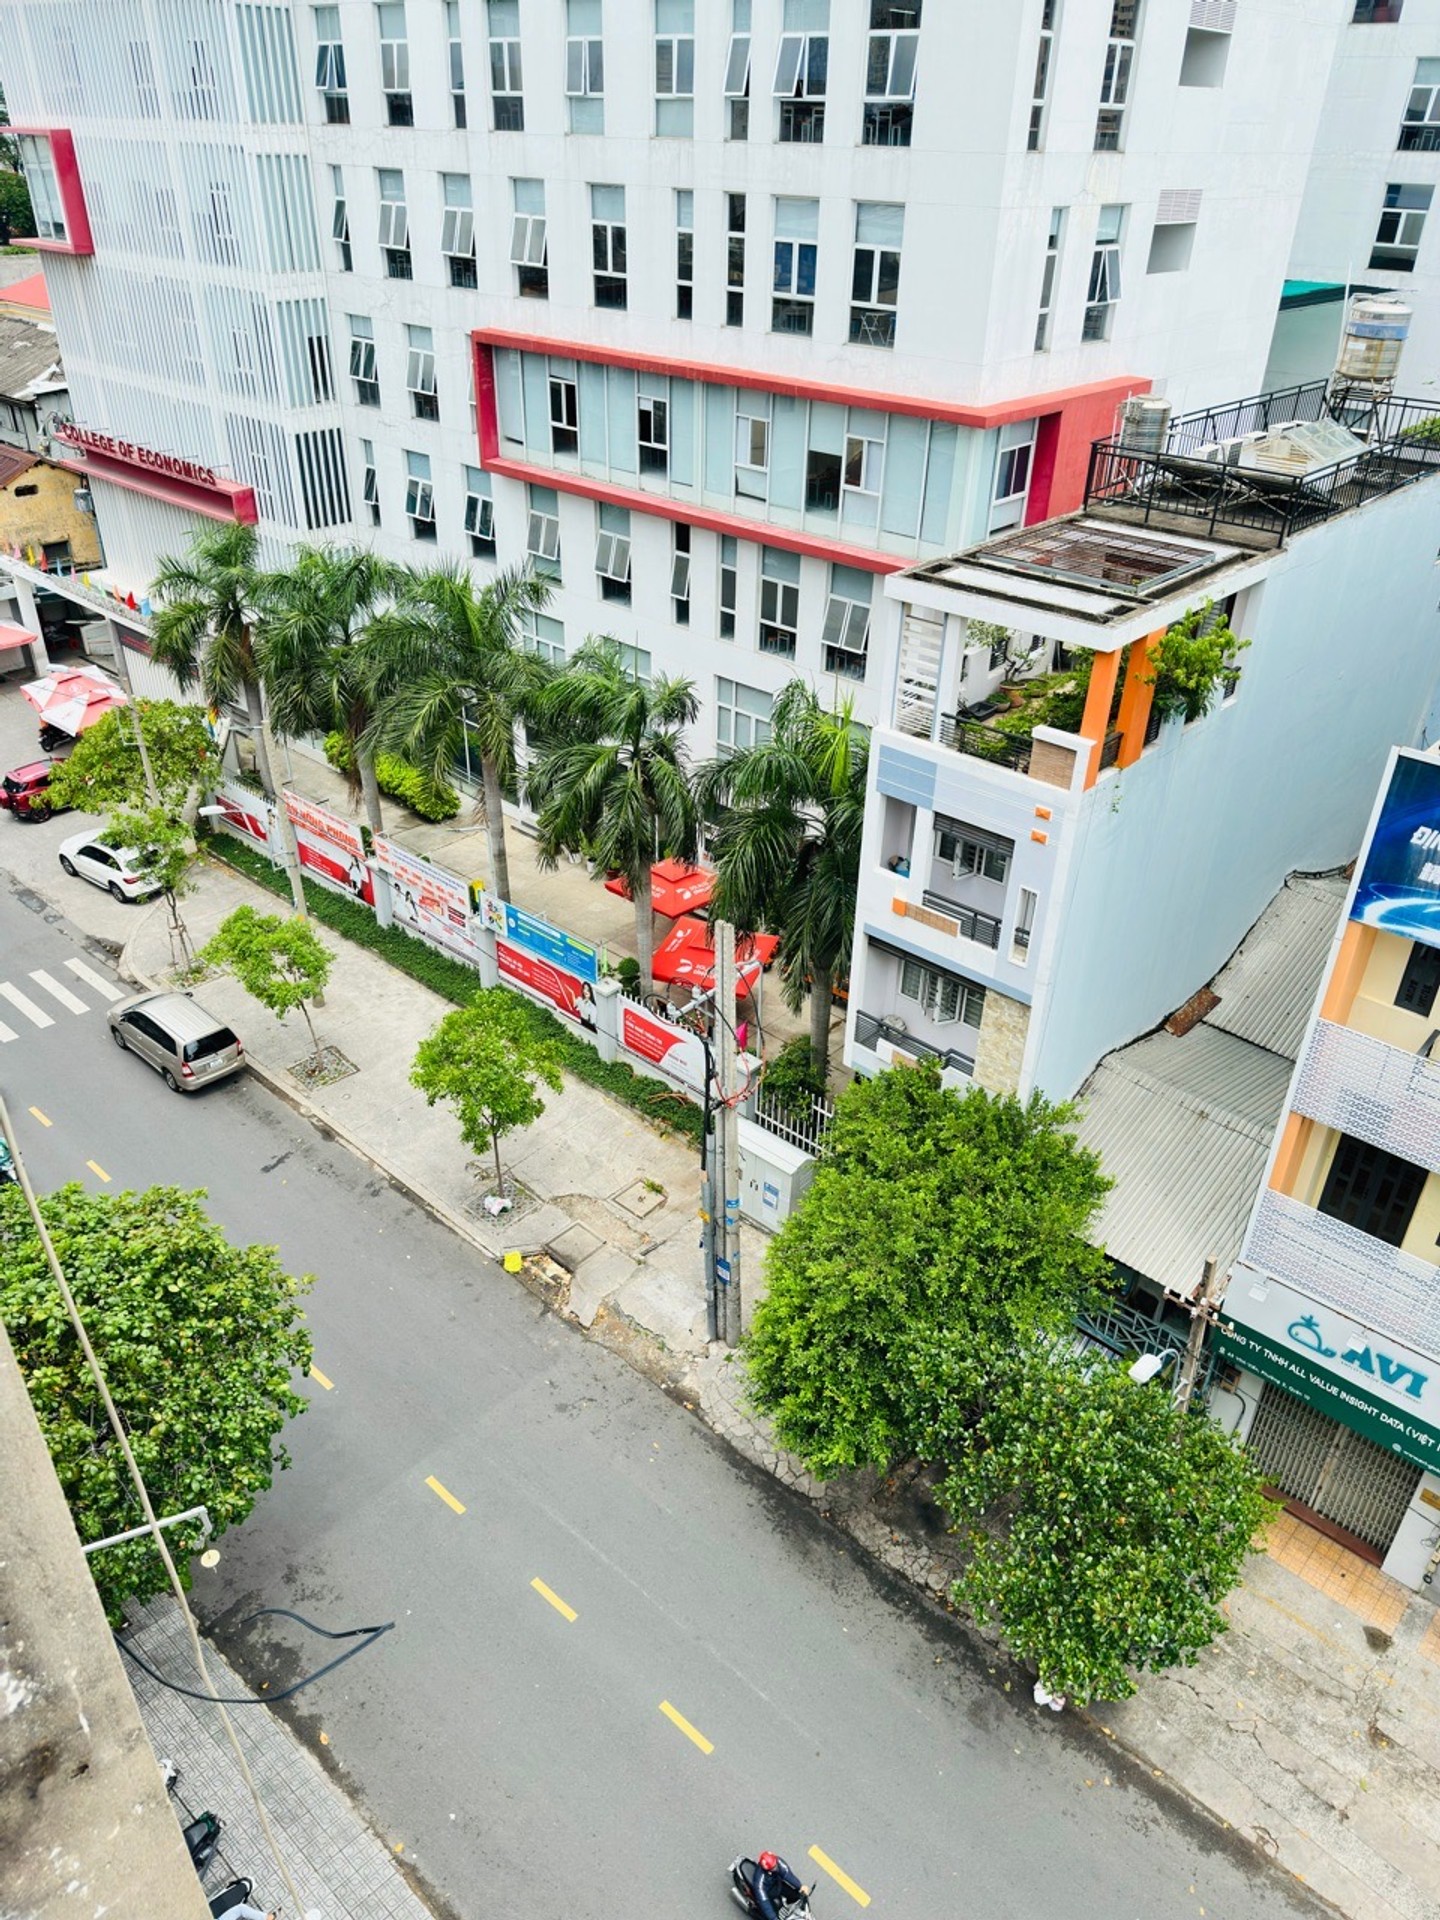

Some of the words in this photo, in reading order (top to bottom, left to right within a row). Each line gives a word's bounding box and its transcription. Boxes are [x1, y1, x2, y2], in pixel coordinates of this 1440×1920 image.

[61, 423, 117, 453] COLLEGE
[119, 440, 134, 459] OF
[136, 446, 216, 487] ECONOMICS
[1248, 1340, 1262, 1352] TY
[1263, 1348, 1289, 1368] TNHH
[1288, 1364, 1306, 1379] ALL
[1309, 1373, 1340, 1397] VALUE
[1339, 1390, 1379, 1417] INSIGHT
[1379, 1413, 1404, 1432] DATA
[1341, 1346, 1428, 1398] AVI
